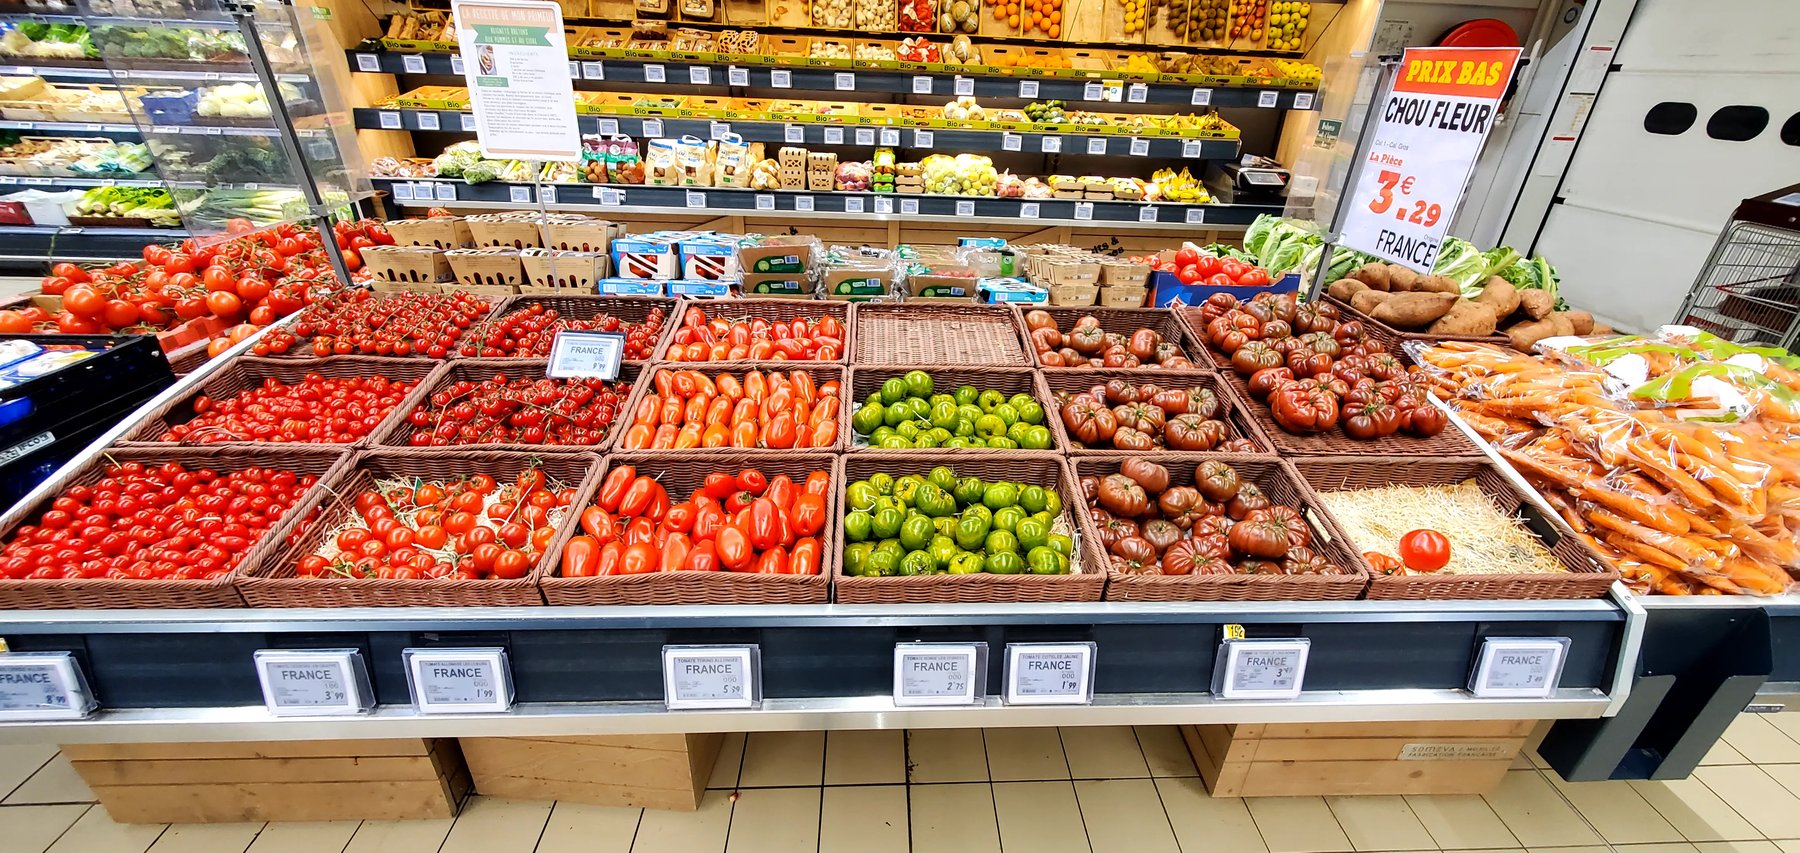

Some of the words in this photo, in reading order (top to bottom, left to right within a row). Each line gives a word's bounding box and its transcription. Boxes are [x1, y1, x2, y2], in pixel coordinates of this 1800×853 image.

[1405, 59, 1458, 83] PRIX
[1456, 61, 1503, 87] BAS
[1384, 96, 1428, 127] CHOU
[1428, 101, 1492, 134] FLEUR
[1369, 151, 1379, 162] La
[1380, 153, 1403, 166] Pièce
[1376, 229, 1438, 267] FRANCE
[570, 346, 604, 355] FRANCE
[1028, 660, 1072, 670] FRANCE
[1246, 657, 1287, 666] FRANCE
[1501, 655, 1543, 665] FRANCE
[685, 664, 732, 674] FRANCE
[913, 662, 958, 671] FRANCE
[281, 670, 332, 680] FRANCE
[433, 668, 482, 678] FRANCE
[0, 673, 51, 684] FRANCE
